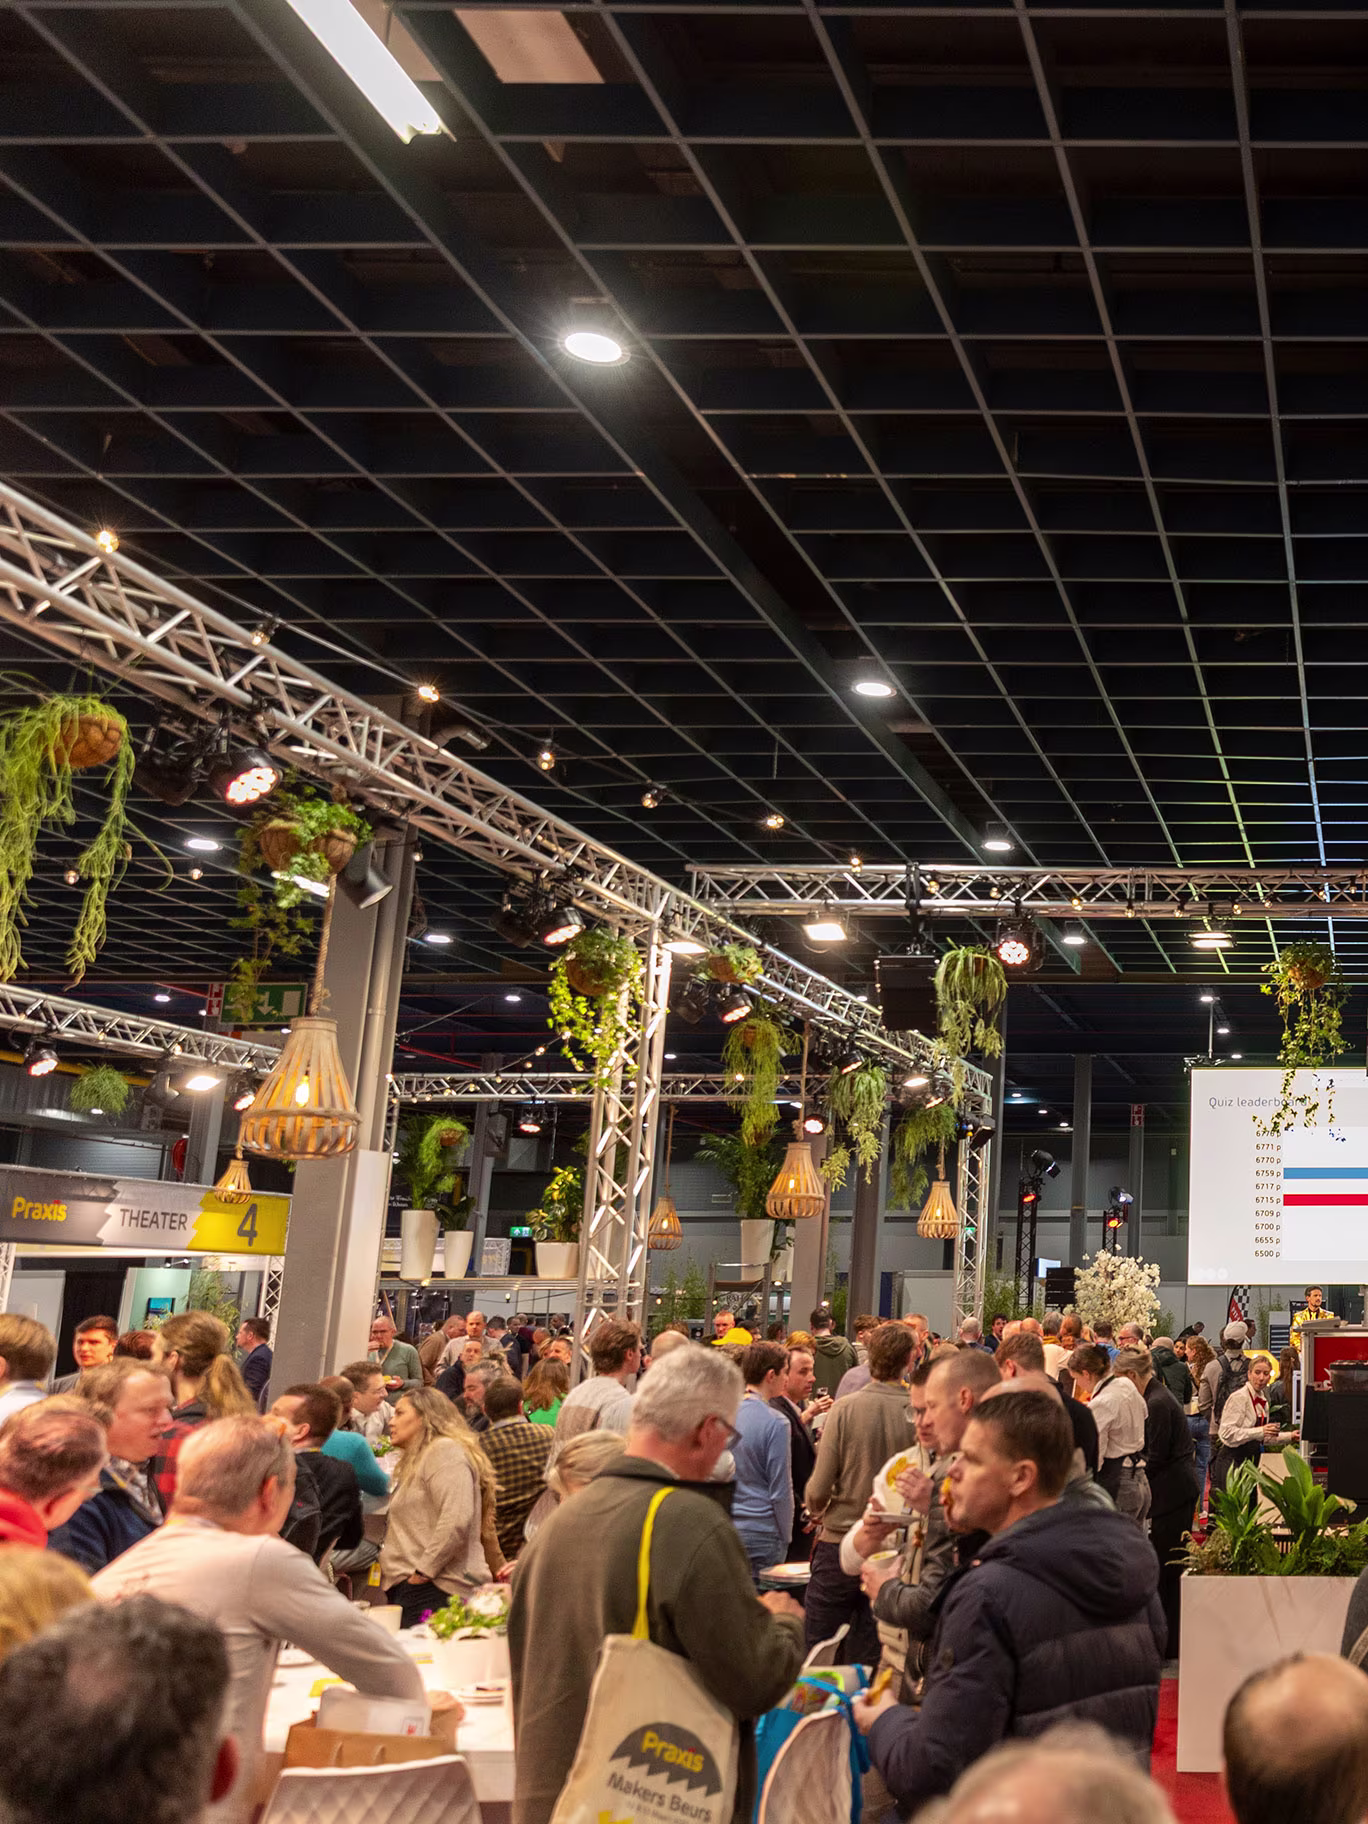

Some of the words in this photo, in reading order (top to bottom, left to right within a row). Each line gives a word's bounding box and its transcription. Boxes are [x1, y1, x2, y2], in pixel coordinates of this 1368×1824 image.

[1208, 1096, 1234, 1109] Quiz
[1237, 1096, 1308, 1108] leaderboard
[11, 1196, 68, 1222] Praxis
[1255, 1196, 1274, 1204] 6715
[120, 1207, 189, 1231] THEATER
[237, 1203, 258, 1247] 4
[641, 1730, 704, 1773] Praxis
[606, 1771, 666, 1808] Makers
[669, 1794, 713, 1823] Beurs
